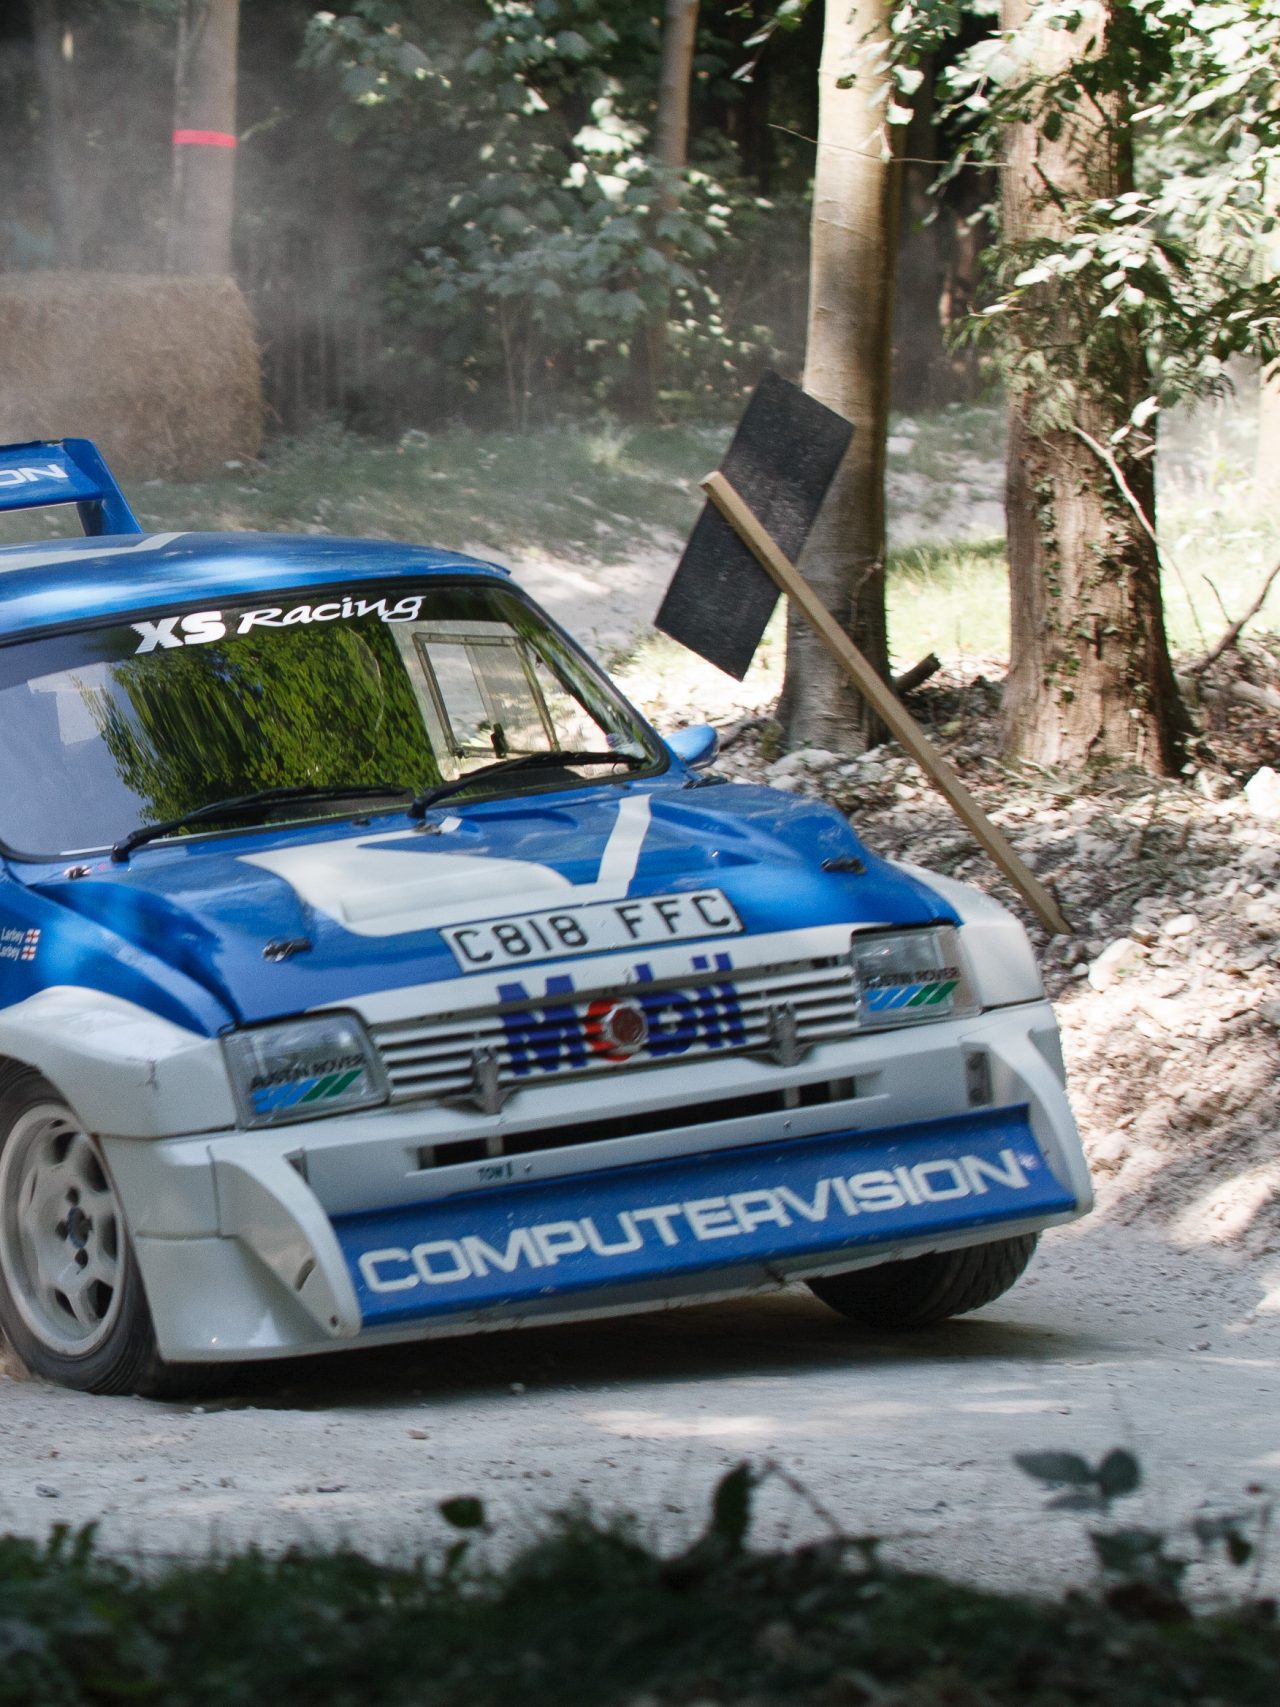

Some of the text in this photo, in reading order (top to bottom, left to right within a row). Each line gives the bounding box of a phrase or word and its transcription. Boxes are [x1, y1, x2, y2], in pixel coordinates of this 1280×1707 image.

[130, 595, 427, 655] XS Racing
[1, 926, 25, 946] Larbey
[452, 894, 731, 963] C818 FFC
[356, 1148, 1031, 1294] COMPUTERVISION
